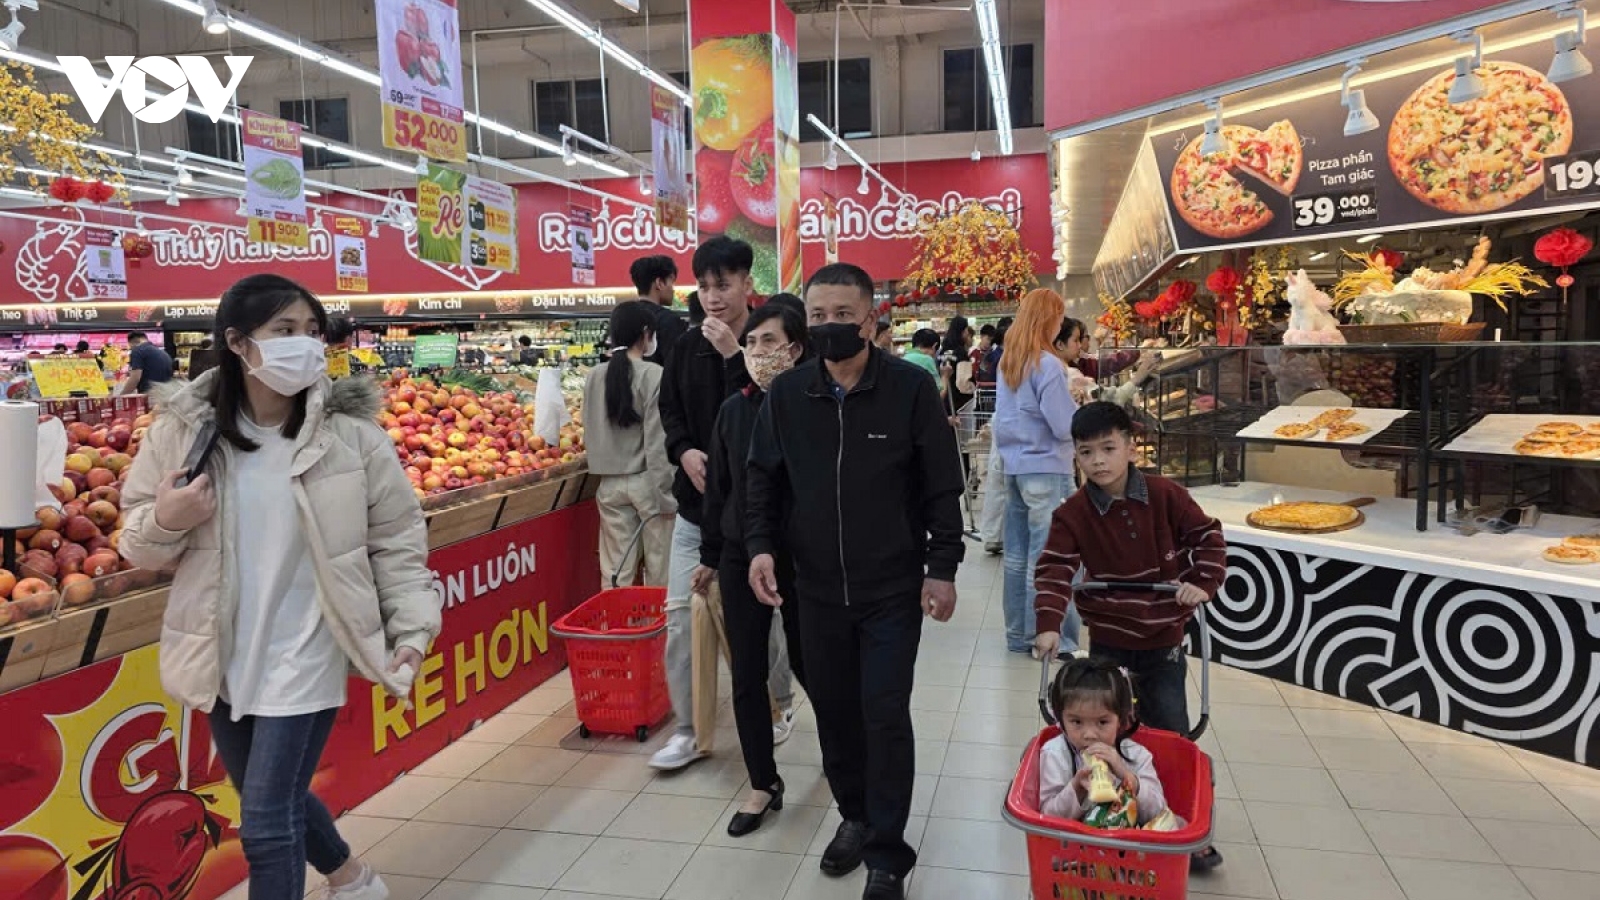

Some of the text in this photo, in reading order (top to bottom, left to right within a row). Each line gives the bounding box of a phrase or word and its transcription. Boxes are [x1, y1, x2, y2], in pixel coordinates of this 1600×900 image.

[394, 109, 459, 152] 52.000
[1308, 159, 1340, 172] Pizza
[1320, 168, 1375, 186] Tam giác
[258, 220, 300, 243] 11.900
[544, 218, 604, 246] Ru
[153, 227, 221, 264] Thủy
[323, 299, 350, 315] guội
[418, 295, 462, 310] Kim chi
[532, 293, 557, 310] Đậu
[2, 309, 21, 320] heo
[62, 306, 84, 321] Thịt
[164, 304, 186, 319] Lạp
[473, 542, 536, 597] LUÔN
[454, 601, 549, 704] HƠN
